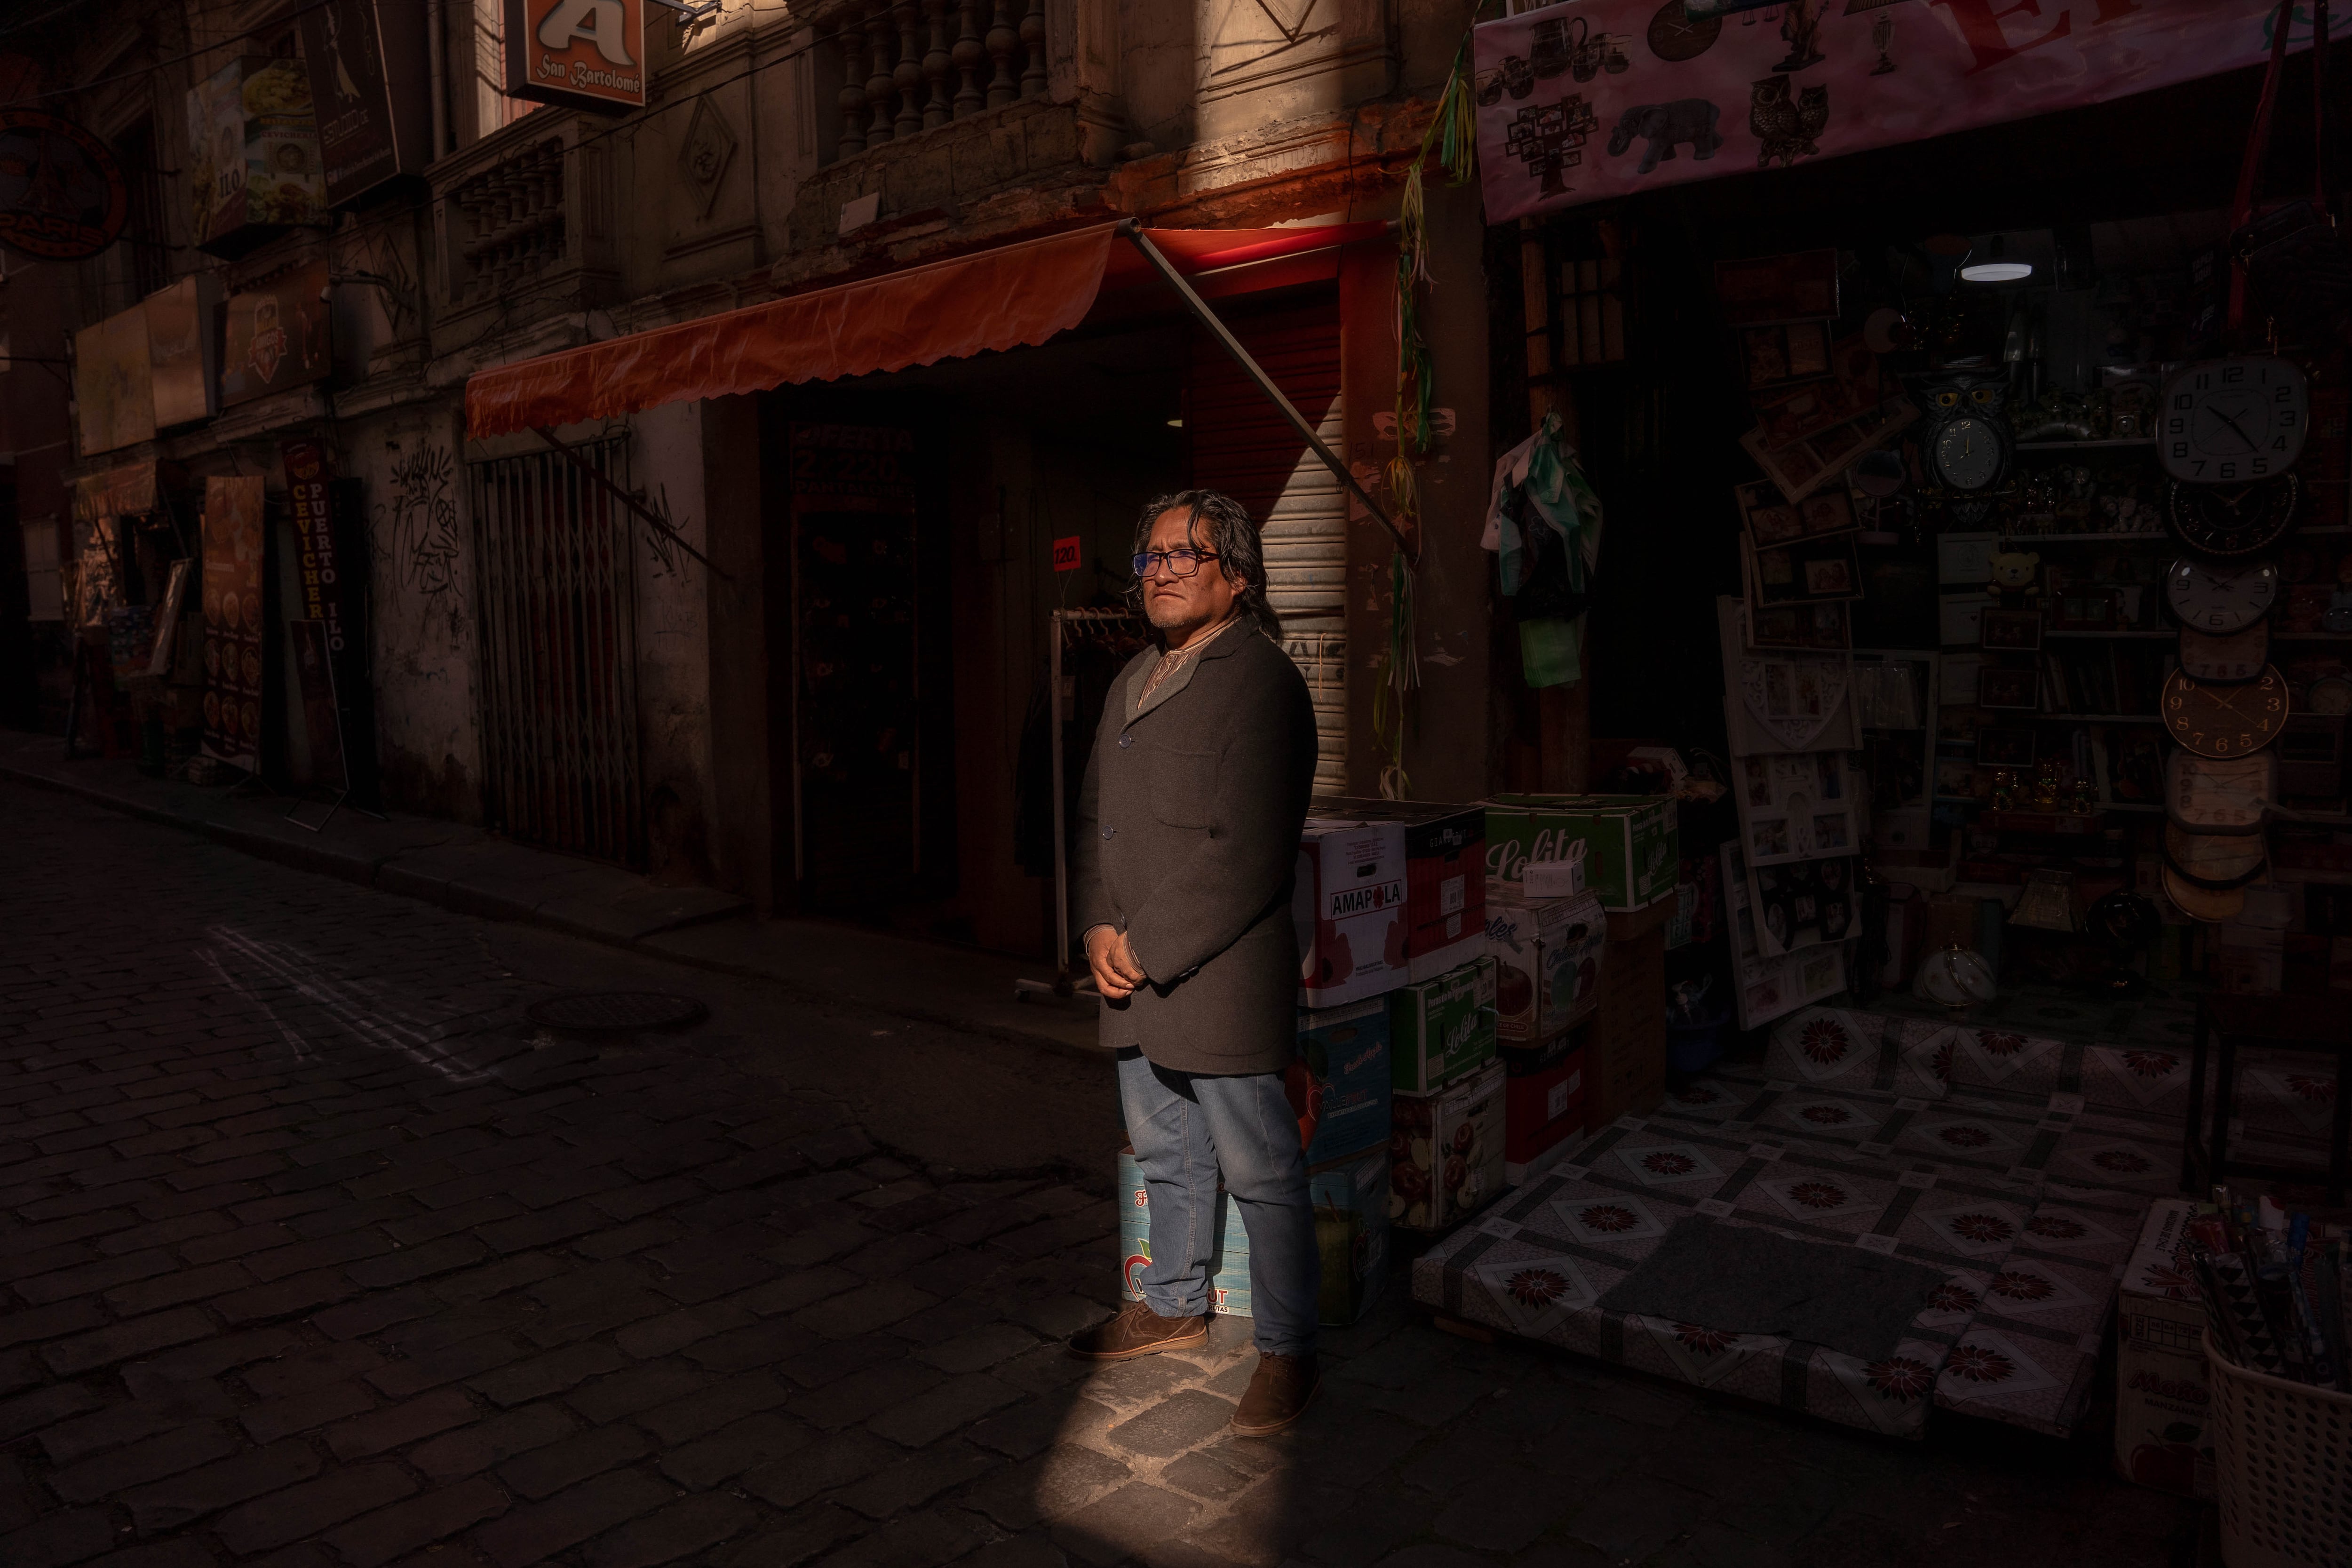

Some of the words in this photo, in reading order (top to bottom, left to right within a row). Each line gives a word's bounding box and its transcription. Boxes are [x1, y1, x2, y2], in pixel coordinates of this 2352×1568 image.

[536, 53, 566, 80] San
[570, 61, 640, 93] Bartolomé
[0, 213, 104, 247] PARIS
[2196, 374, 2209, 390] 11
[2223, 366, 2243, 383] 12
[2262, 368, 2266, 384] 1
[2175, 394, 2192, 410] 10
[2275, 386, 2291, 403] 2
[2169, 418, 2184, 434] 9
[2280, 410, 2296, 426] 3
[2173, 442, 2188, 458] 8
[2272, 435, 2288, 451] 4
[2191, 460, 2207, 477] 7
[2221, 462, 2235, 478] 6
[2252, 458, 2268, 474] 5
[795, 481, 915, 498] PANTALONES
[293, 484, 324, 619] CEVICHER
[310, 483, 336, 584] PUERTO
[328, 602, 345, 652] ILO
[2176, 579, 2191, 591] 9
[2254, 582, 2268, 594] 3
[2209, 614, 2224, 626] 6
[2178, 678, 2195, 691] 10
[2259, 677, 2273, 691] 2
[2169, 696, 2183, 710] 9
[2266, 698, 2280, 711] 3
[2176, 716, 2189, 730] 8
[2257, 718, 2270, 732] 4
[2193, 732, 2205, 746] 7
[2215, 738, 2228, 752] 6
[2239, 734, 2252, 748] 5
[1486, 828, 1588, 880] Lolita
[1428, 996, 1441, 1009] Peras
[1445, 1012, 1478, 1058] Lolita
[2163, 1210, 2179, 1233] MANZANAS
[2155, 1238, 2167, 1252] CHILE
[1208, 1304, 1228, 1313] RUTAS
[2136, 1317, 2145, 1337] SIZE
[2127, 1369, 2210, 1404] Moño
[2145, 1398, 2203, 1417] MANZANAS
